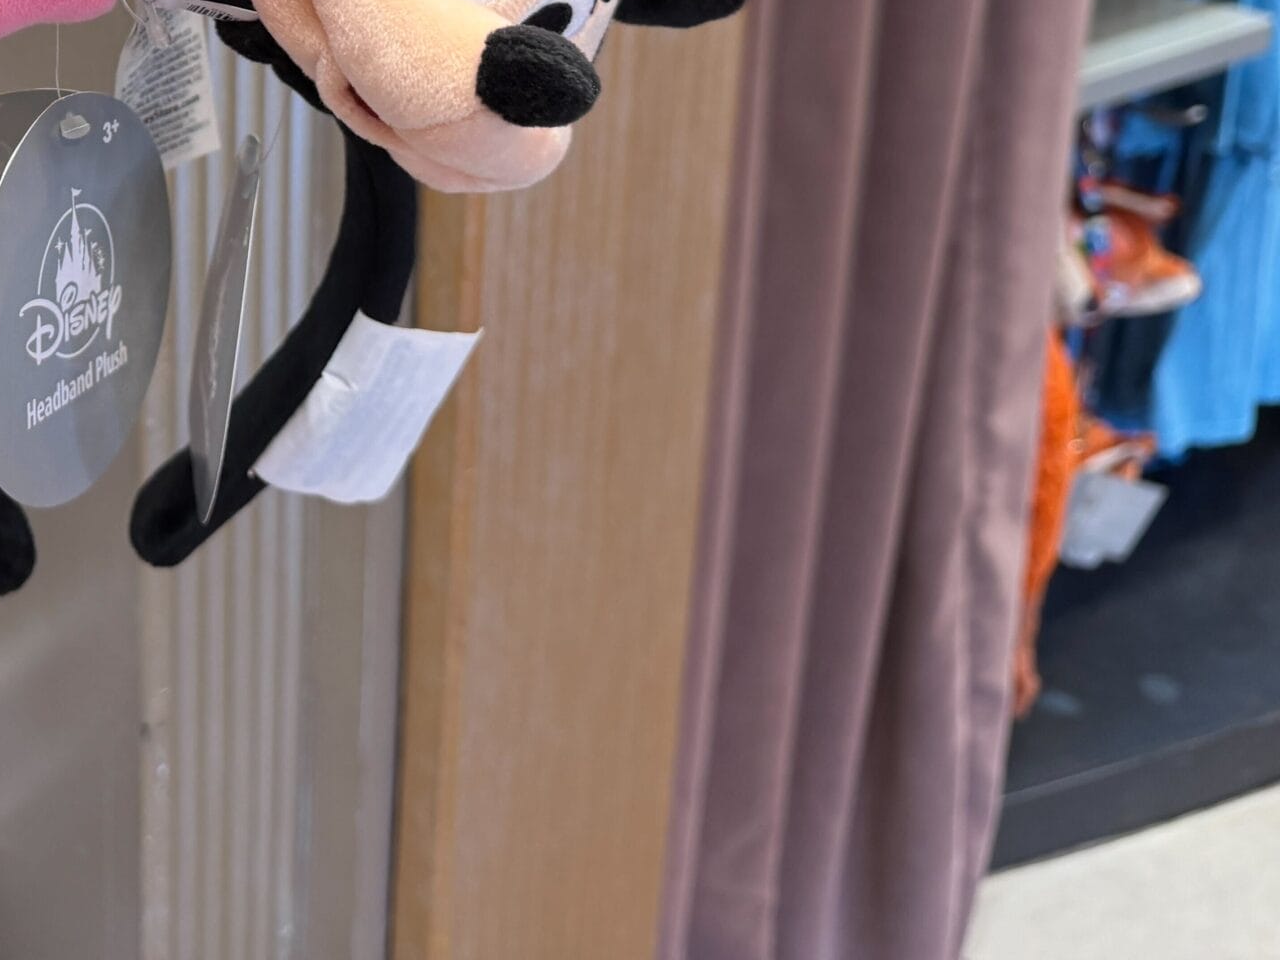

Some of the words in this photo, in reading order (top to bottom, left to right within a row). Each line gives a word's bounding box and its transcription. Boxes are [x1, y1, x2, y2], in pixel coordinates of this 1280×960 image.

[102, 119, 121, 144] 3+
[26, 359, 94, 431] Headband
[94, 341, 129, 384] Plush
